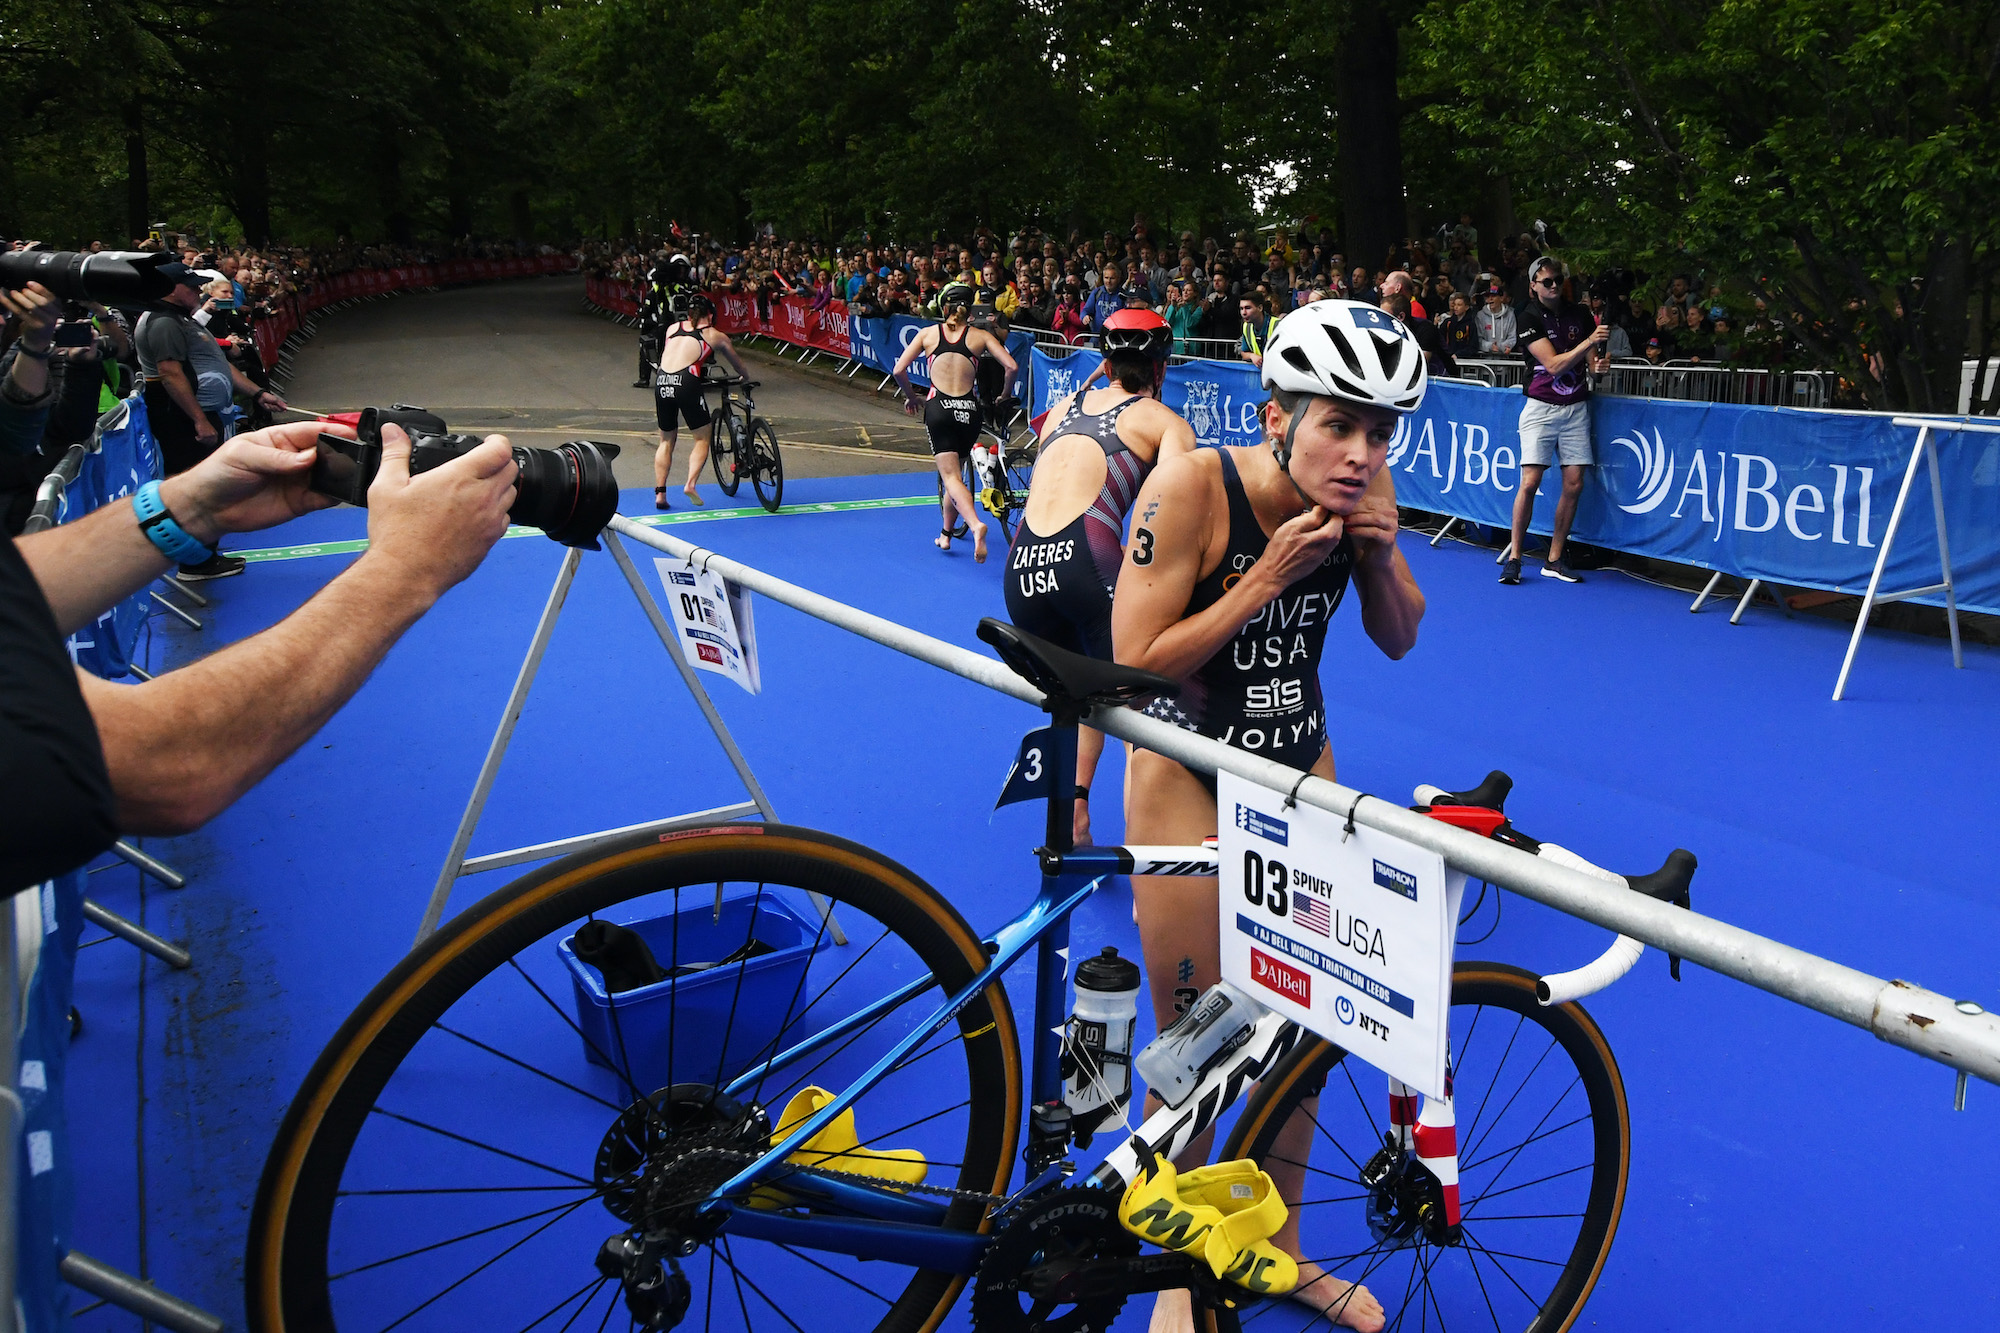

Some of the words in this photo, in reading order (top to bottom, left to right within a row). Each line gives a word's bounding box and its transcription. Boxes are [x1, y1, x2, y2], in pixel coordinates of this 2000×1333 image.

[1367, 310, 1380, 323] 3
[656, 374, 682, 386] COLDWELL
[660, 386, 675, 398] GBR
[940, 399, 977, 412] LEARMONTH
[953, 409, 970, 424] GBR
[1404, 416, 1544, 497] AJBe
[1013, 539, 1075, 570] ZAFERES
[1132, 527, 1156, 568] 3
[1321, 553, 1349, 567] OKA
[1019, 569, 1060, 598] USA
[680, 593, 704, 623] 01
[1241, 589, 1340, 636] PIVEY
[1234, 633, 1309, 671] USA
[1287, 705, 1304, 715] SPORT
[1216, 710, 1318, 750] JOLYN
[1024, 747, 1043, 782] 3
[1142, 860, 1219, 876] TIM
[1244, 849, 1288, 917] 03
[1375, 862, 1415, 888] TRIATHLON
[1293, 868, 1333, 899] SPIVEY
[1336, 909, 1386, 967] USA
[1259, 929, 1270, 943] AJ
[1271, 933, 1290, 954] BELL
[1291, 942, 1320, 966] WORLD
[1321, 956, 1365, 989] TRIATHLON
[1366, 980, 1391, 1003] LEEDS
[936, 1005, 961, 1030] TAYLOR
[961, 985, 984, 1010] SPIVEY
[1173, 987, 1199, 1014] 3
[1359, 1012, 1390, 1042] NTT
[1029, 1202, 1109, 1232] ROTOR
